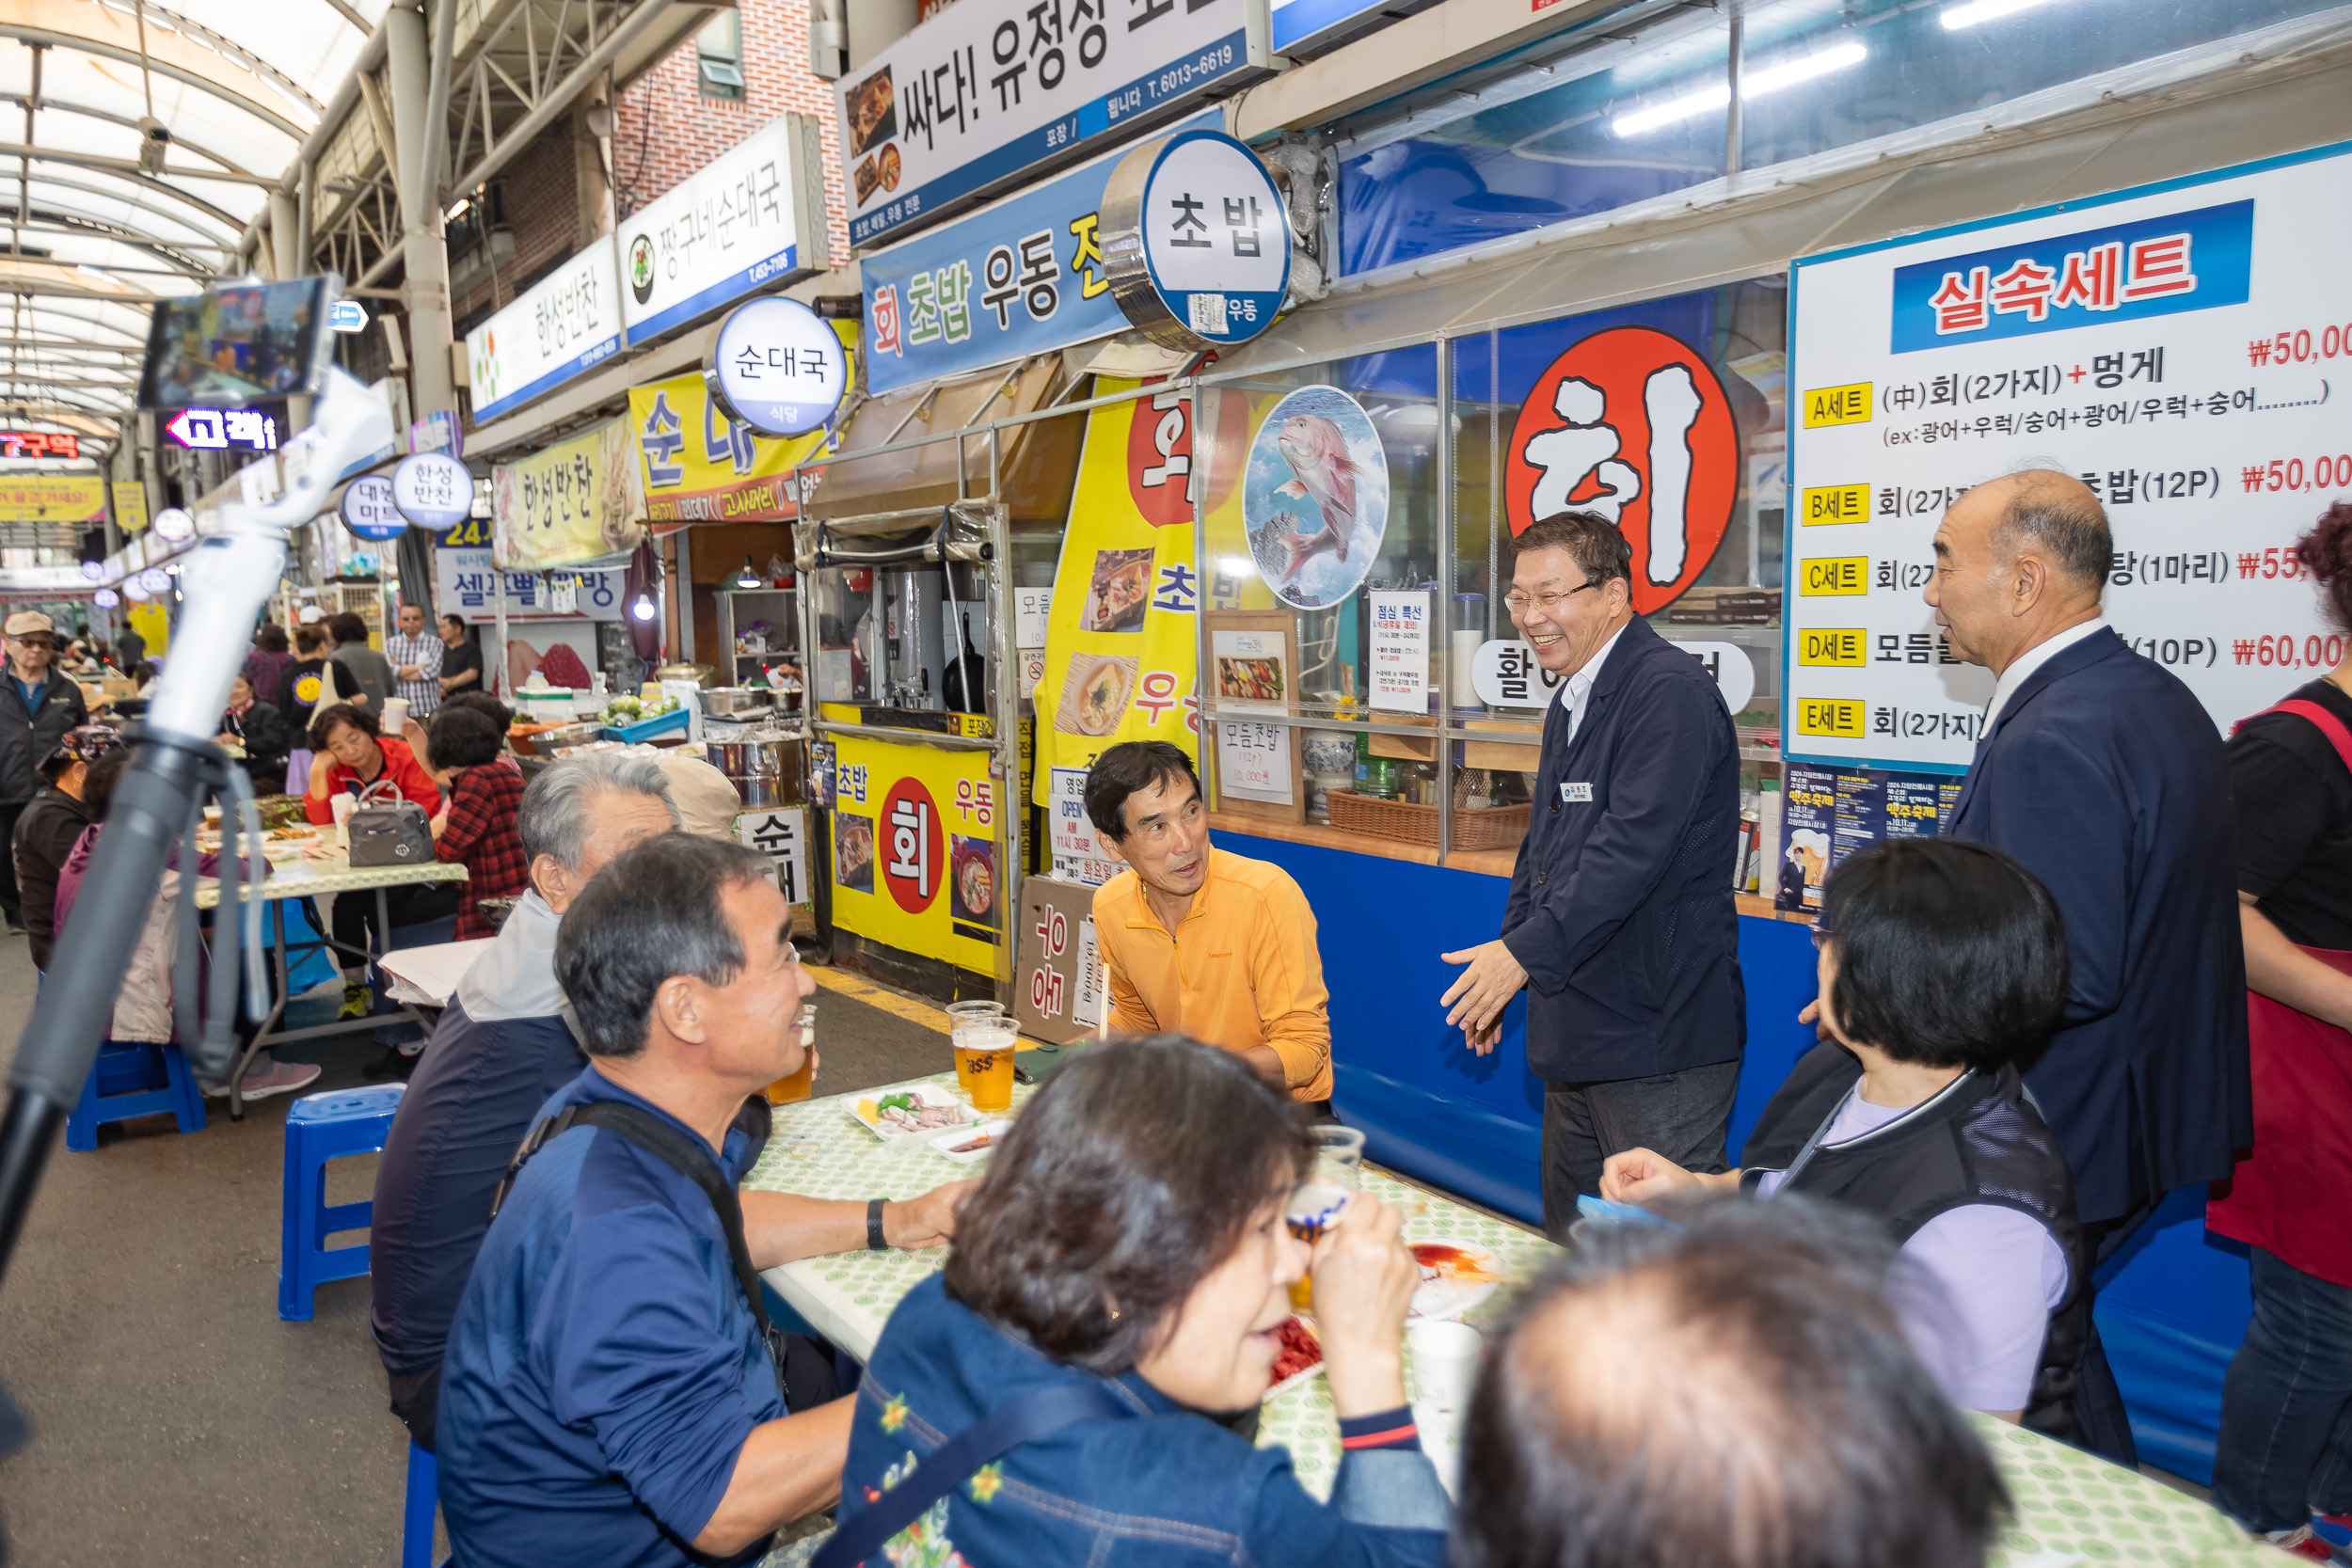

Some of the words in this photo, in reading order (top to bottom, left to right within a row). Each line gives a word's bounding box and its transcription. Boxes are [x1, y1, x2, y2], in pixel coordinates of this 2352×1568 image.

[903, 44, 979, 150] 싸다!
[1046, 123, 1067, 148] 포장
[1107, 87, 1141, 119] 됩니다
[1148, 44, 1232, 99] T.6013-6619
[660, 161, 780, 281] 짱구네순대국
[1169, 192, 1263, 258] 초밥
[872, 284, 903, 358] 회
[907, 260, 971, 345] 초밥
[981, 229, 1060, 331] 우동
[1929, 232, 2198, 336] 실속세트
[535, 265, 598, 358] 한성반찬
[1228, 299, 1258, 322] 우동
[736, 345, 828, 383] 순대국
[1813, 389, 1864, 420] A세트
[2248, 323, 2352, 367] ₩50,00
[187, 407, 277, 450] 고객
[770, 405, 799, 423] 식당
[416, 463, 452, 483] 한성
[524, 452, 593, 532] 한성반찬
[1811, 490, 1859, 518] B세트
[1878, 484, 1971, 518] 회(2가
[2241, 454, 2352, 494] ₩50,00
[415, 485, 453, 506] 반찬
[1810, 562, 1857, 590] C세트
[2236, 547, 2306, 582] ₩55,
[454, 572, 614, 608] 셀프빨방
[1024, 594, 1049, 614] 모듬
[1377, 605, 1396, 620] 점심
[1402, 605, 1422, 620] 특선
[1808, 633, 1856, 661] D세트
[2118, 633, 2217, 668] (10P)
[2232, 634, 2349, 671] ₩60,00
[1807, 704, 1853, 731] E세트
[1227, 723, 1279, 751] 모듬초밥
[837, 762, 868, 803] 초밥
[1788, 790, 1835, 808] 맥주축제
[955, 778, 993, 826] 우동
[1061, 800, 1083, 818] OPEN
[1886, 802, 1937, 820] 맥주축제
[1057, 835, 1071, 849] 11시
[1074, 837, 1090, 852] 30분
[1067, 821, 1077, 834] AM
[890, 799, 928, 898] 회
[1084, 861, 1112, 880] 화요일
[1031, 904, 1067, 1019] 우동
[966, 1054, 994, 1075] ass
